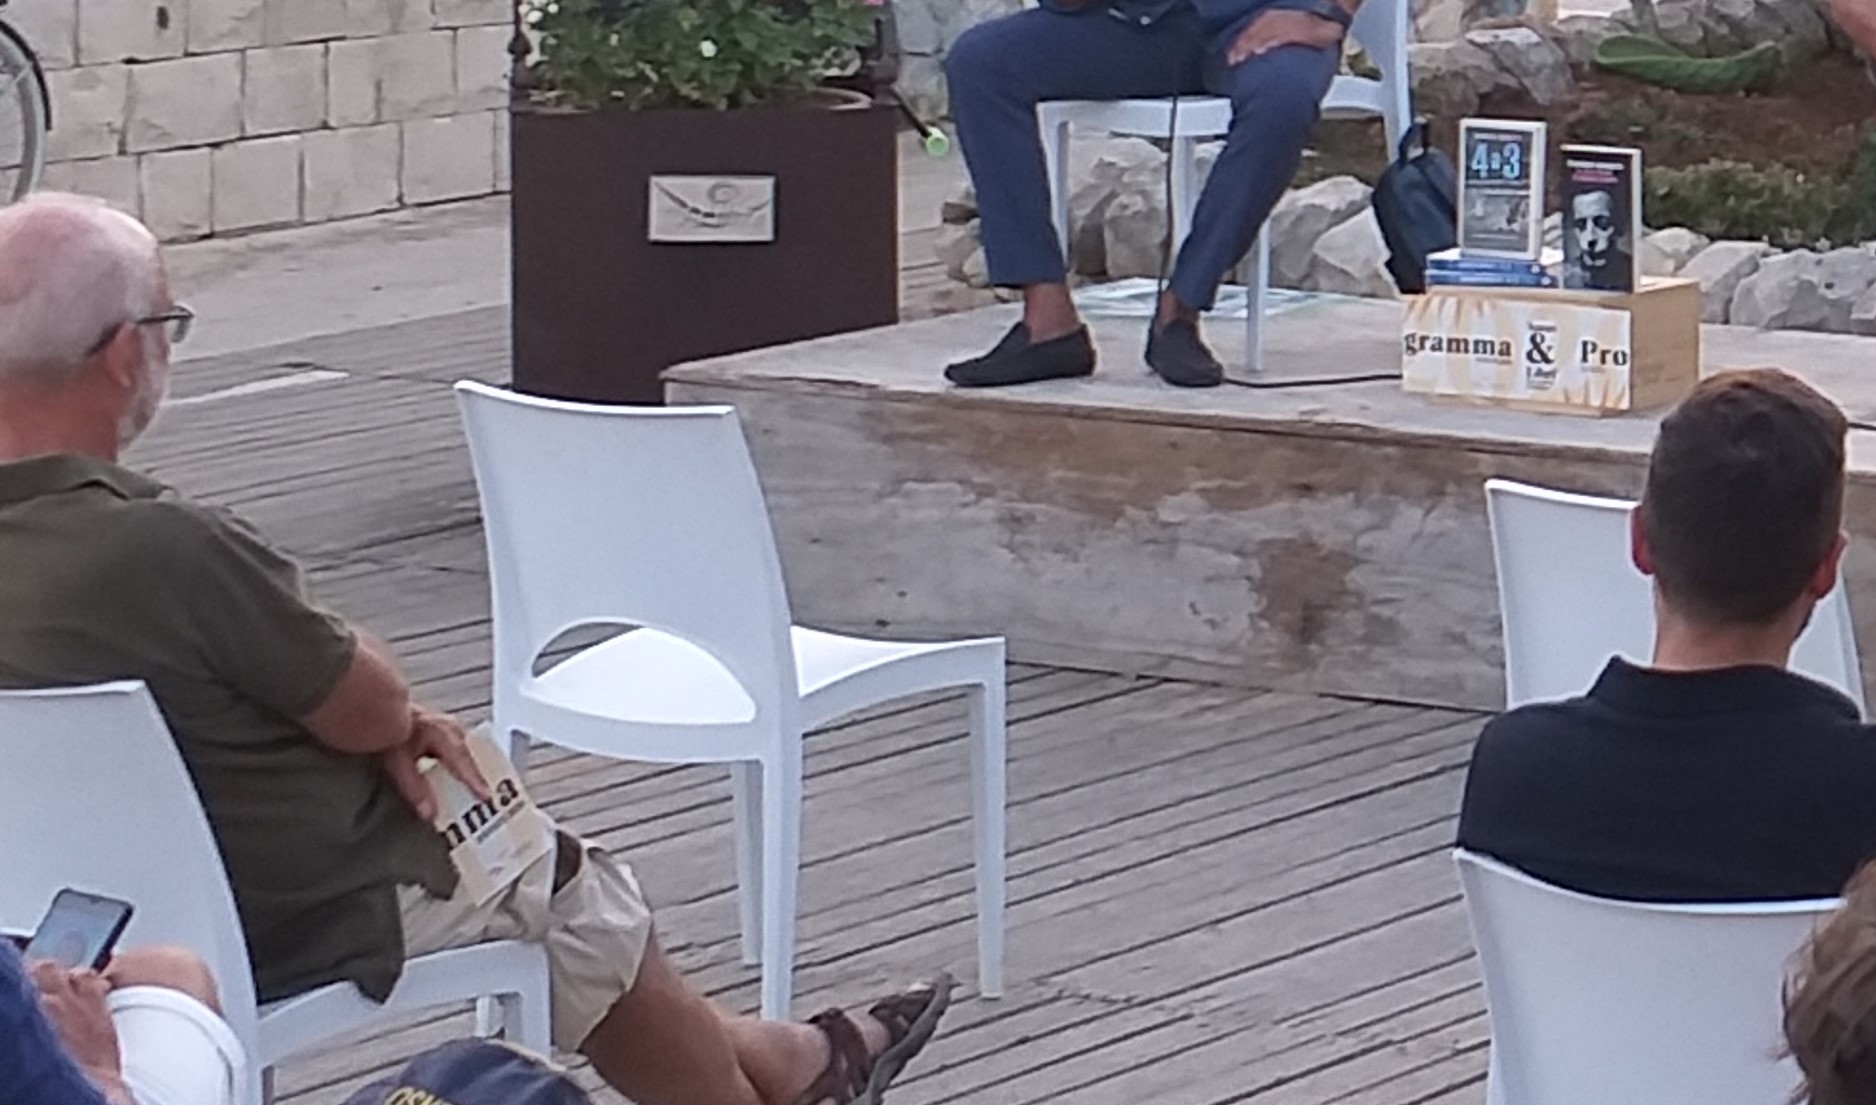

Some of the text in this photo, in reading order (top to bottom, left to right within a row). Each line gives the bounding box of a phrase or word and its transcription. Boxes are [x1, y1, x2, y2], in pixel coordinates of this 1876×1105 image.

[1404, 331, 1629, 366] gramma & Pro
